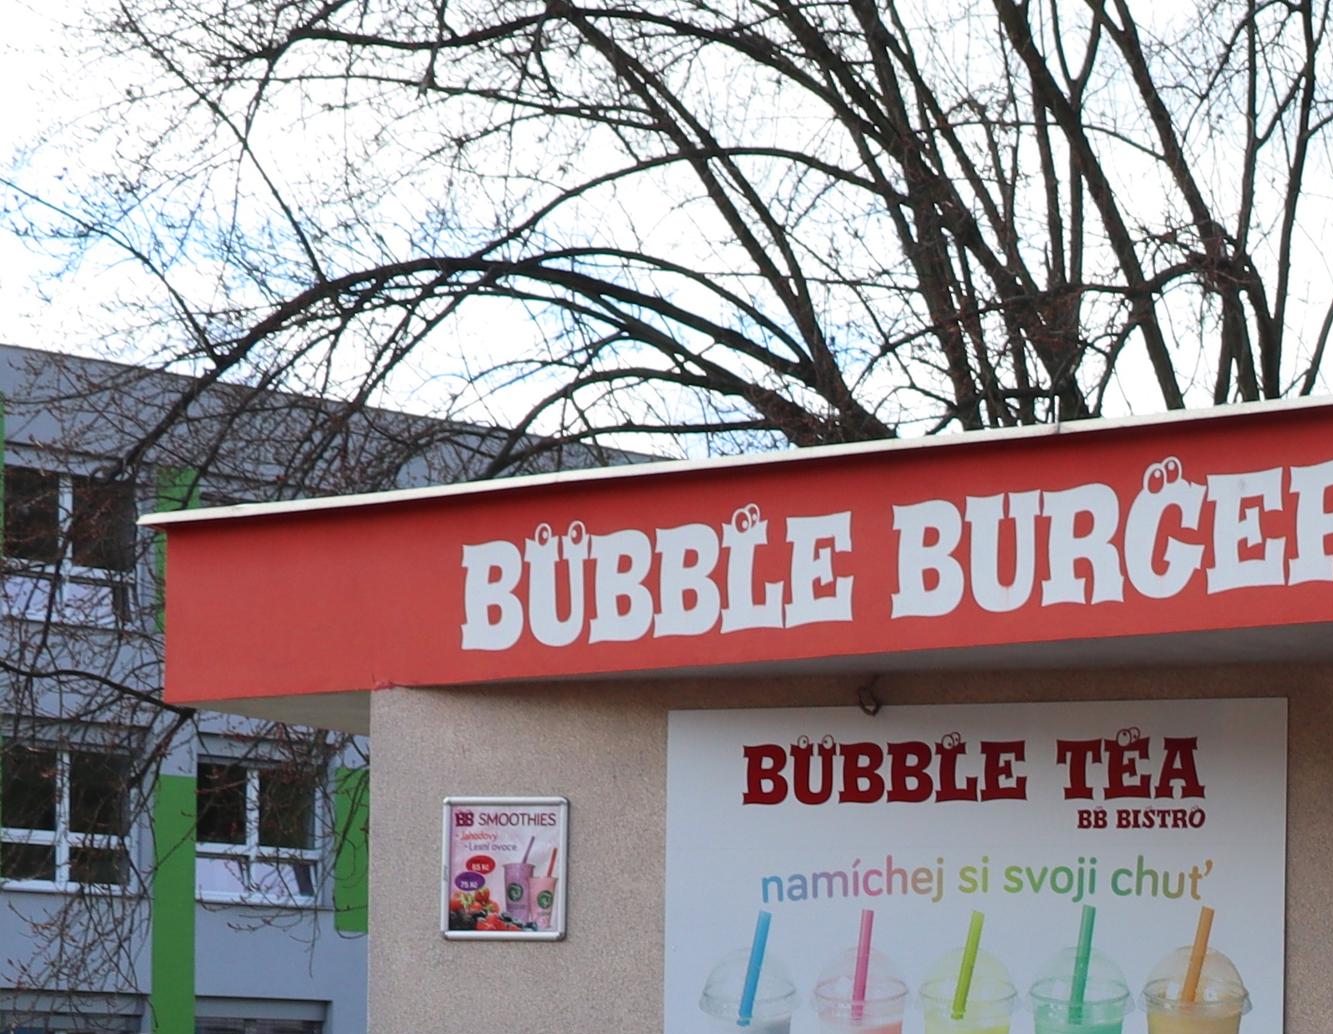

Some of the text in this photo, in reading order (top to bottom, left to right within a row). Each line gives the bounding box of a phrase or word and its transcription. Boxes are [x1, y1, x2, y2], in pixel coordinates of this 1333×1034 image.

[461, 505, 853, 652] BUBBLE
[742, 727, 1206, 806] BUBBLE TEA
[478, 812, 556, 827] SMOOTHIES
[1077, 805, 1206, 830] BB BISTRO
[761, 855, 945, 903] namíchej
[958, 855, 989, 893] si
[1003, 857, 1098, 903] svoji
